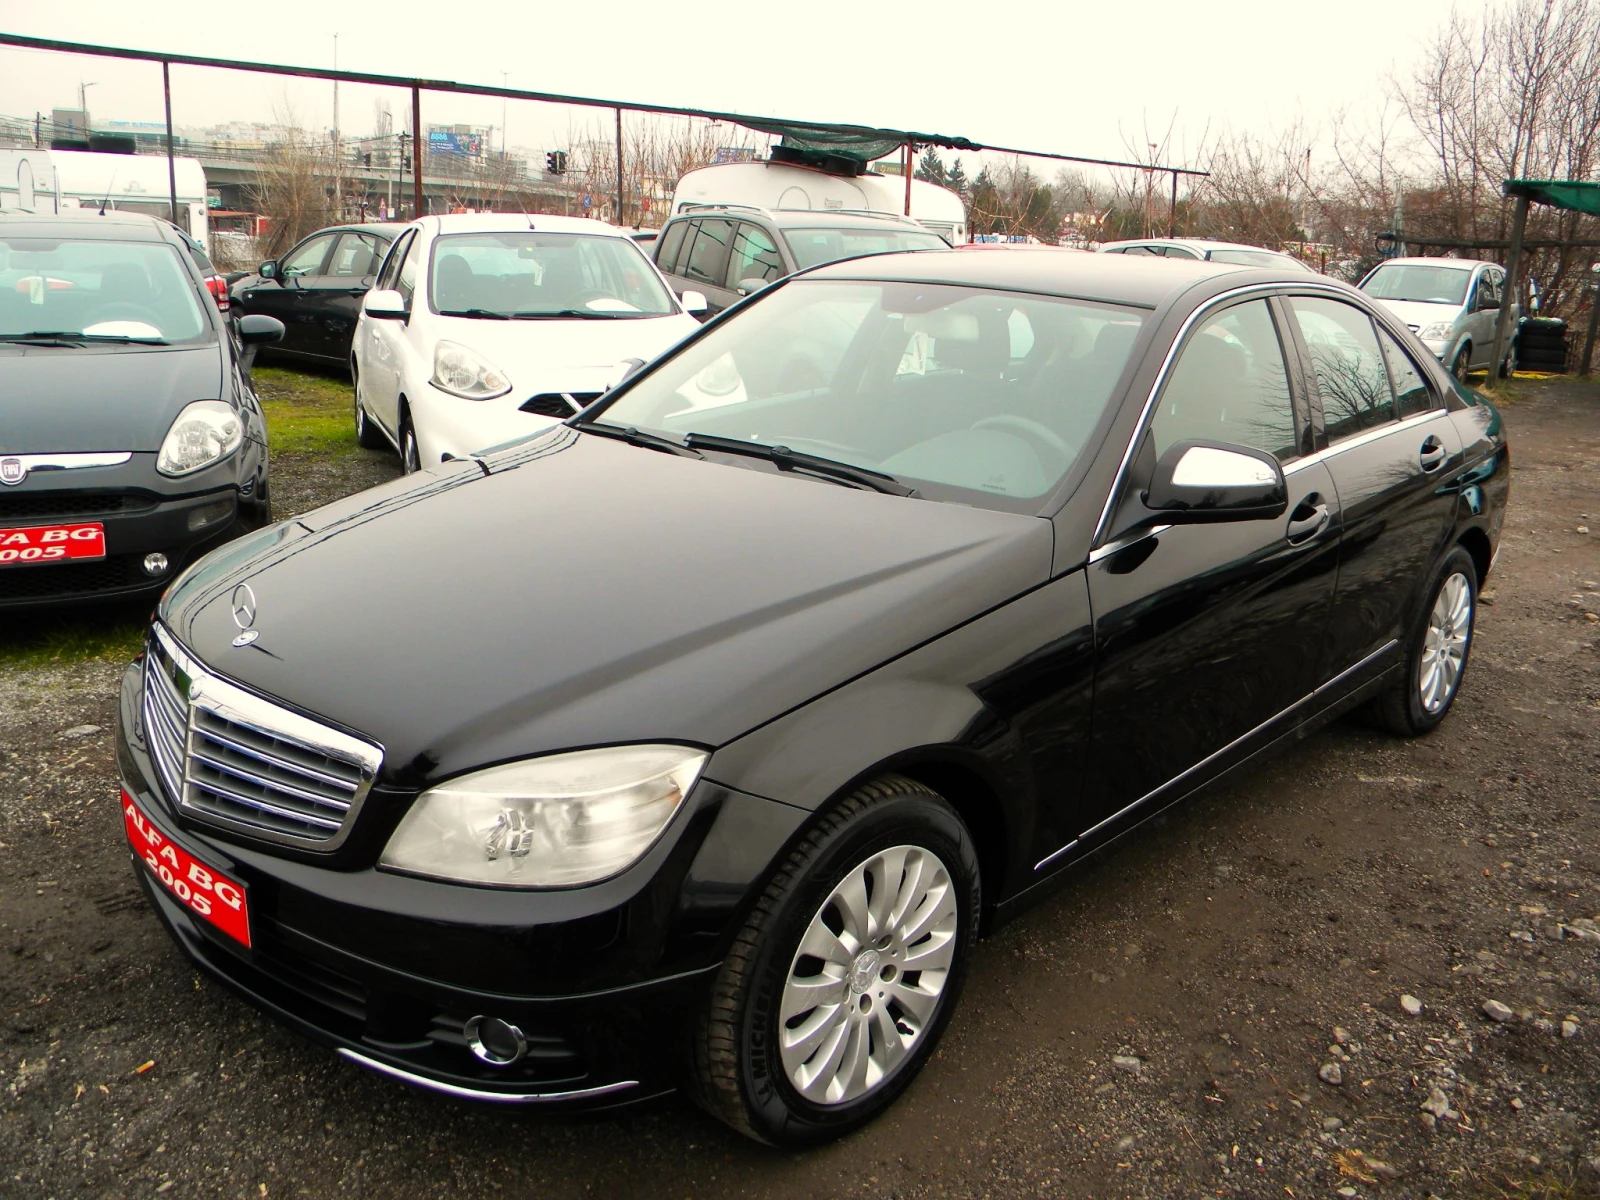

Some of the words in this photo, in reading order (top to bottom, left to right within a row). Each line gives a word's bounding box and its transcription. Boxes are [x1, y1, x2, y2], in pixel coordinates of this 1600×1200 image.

[3, 464, 19, 475] FIAT
[41, 528, 99, 542] BG
[126, 804, 179, 869] ALFA
[187, 862, 242, 911] BG
[146, 849, 212, 916] 2005
